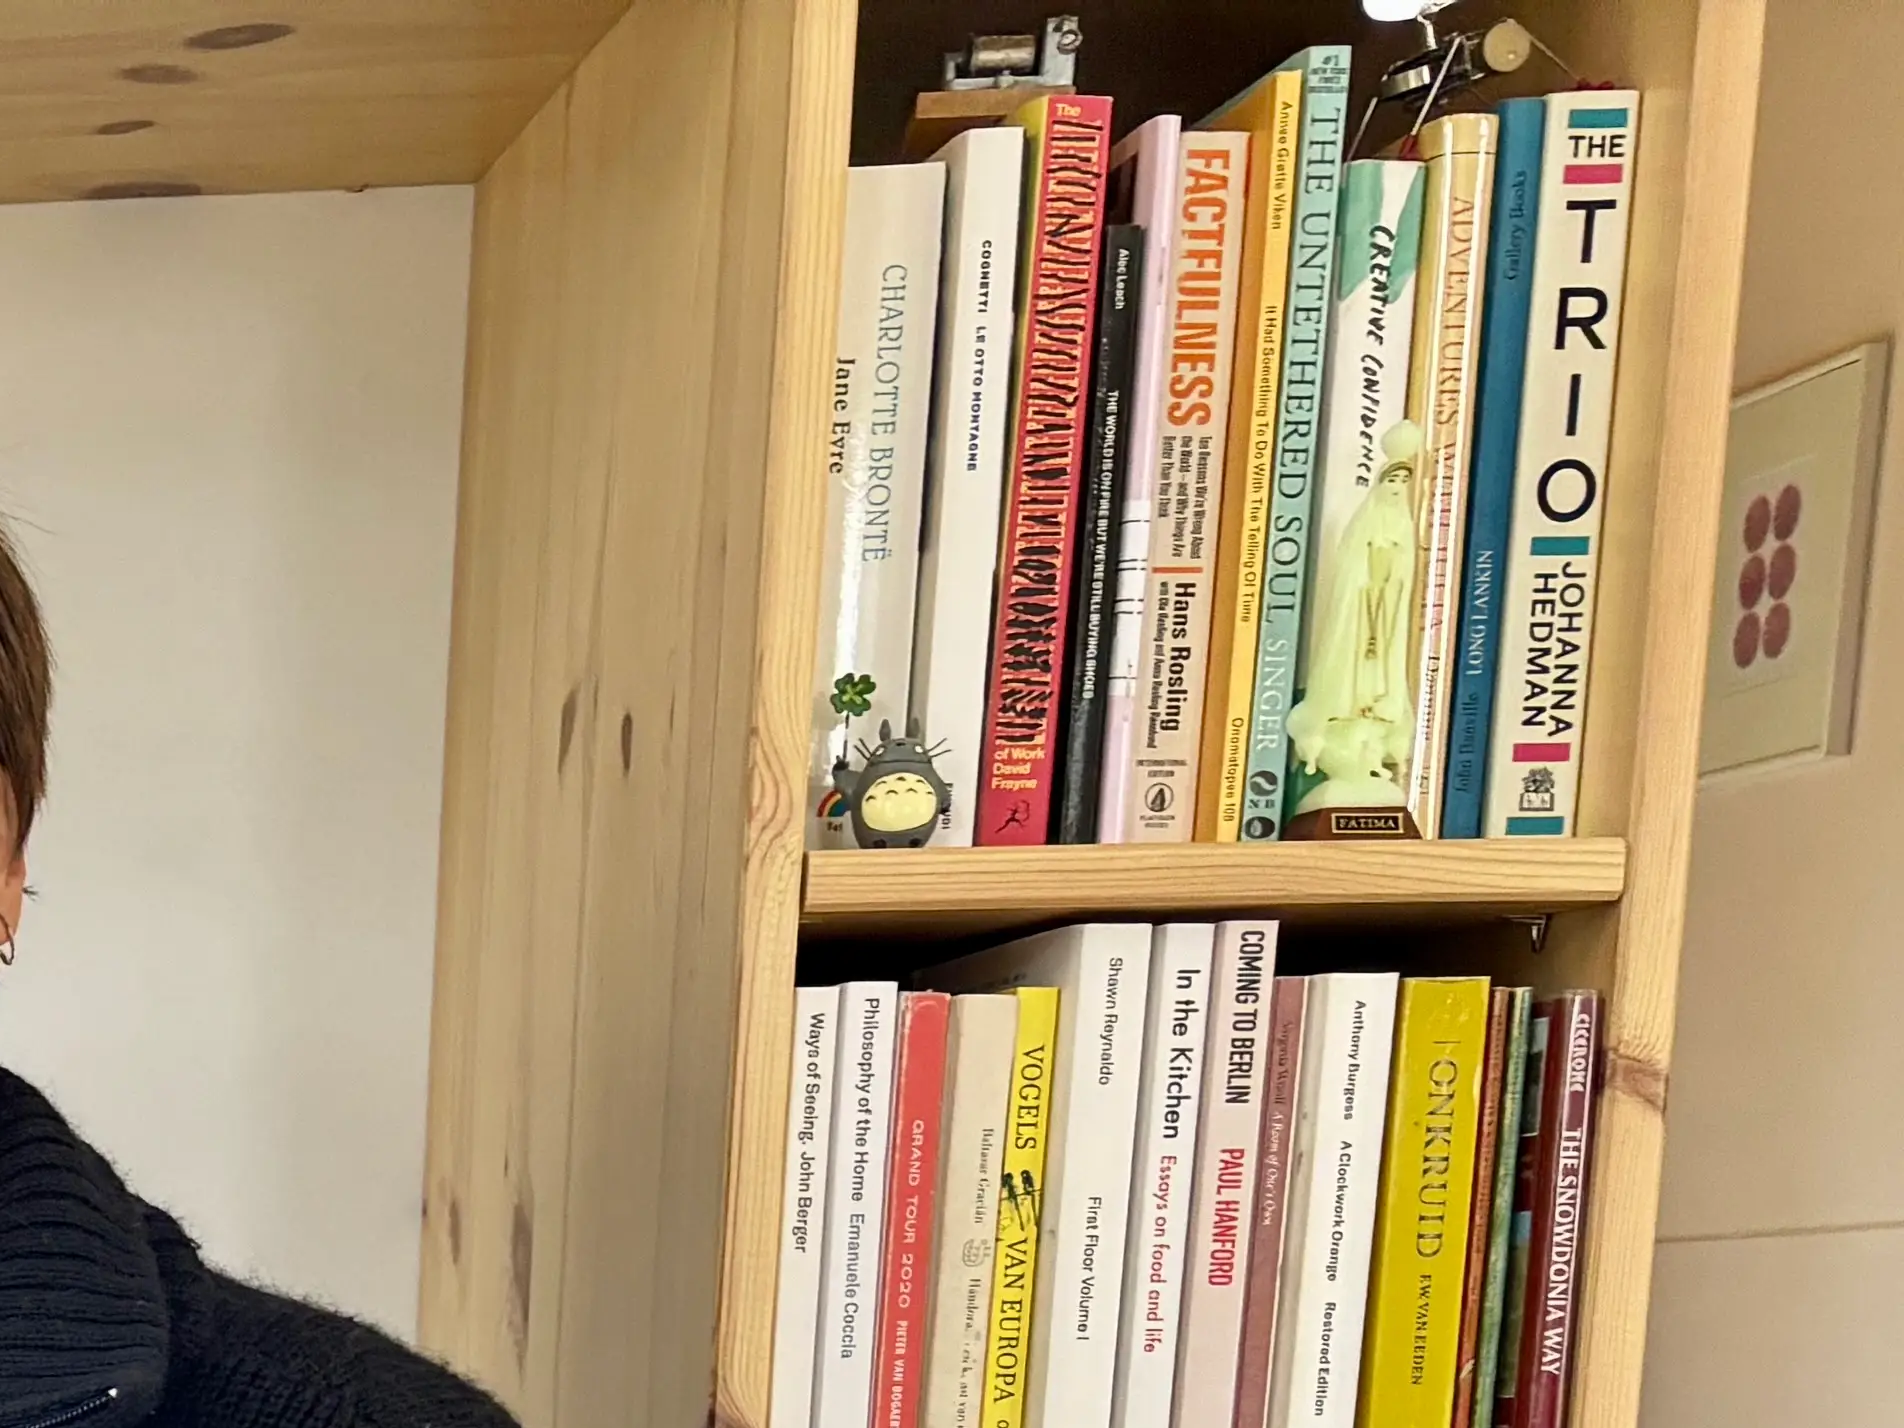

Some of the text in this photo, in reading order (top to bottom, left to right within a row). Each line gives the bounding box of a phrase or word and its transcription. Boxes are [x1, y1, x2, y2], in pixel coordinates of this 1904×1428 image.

[1304, 107, 1341, 194] THE
[1568, 134, 1628, 158] THE
[1117, 248, 1131, 272] Alec
[1167, 150, 1231, 429] FACTFULNESS
[1437, 197, 1475, 427] ADVENTURES
[966, 239, 993, 471] COGNETTI LE OTTO MONTAGNE
[1277, 211, 1331, 499] UNTETHERED
[1355, 225, 1396, 488] CREATIVE CONFIDENCE
[1537, 199, 1617, 523] TRIO
[828, 357, 856, 476] Jane Eyre
[861, 264, 908, 562] CHARLOTTE BRONTË
[1171, 583, 1197, 639] Hans
[1266, 514, 1302, 624] SOUL
[1465, 550, 1494, 676] LONG LANKIN
[1159, 646, 1192, 732] Rosling
[1255, 637, 1288, 751] SINGER
[1520, 572, 1559, 728] HEDMAN
[1547, 561, 1587, 738] JOHANNA
[1338, 816, 1396, 830] FATIMA
[806, 1013, 825, 1056] Ways
[1105, 958, 1123, 1009] Shawn
[806, 1061, 821, 1079] of
[1014, 1044, 1045, 1150] VOGELS
[1098, 1014, 1118, 1085] Reynaldo
[1143, 968, 1201, 1353] In the Kitchen Essays on food and life
[1208, 930, 1266, 1286] COMING TO BERLIN PAUL HANFORD
[1414, 1058, 1460, 1259] ONKRUID
[792, 1196, 812, 1253] Berger
[799, 1152, 816, 1192] John
[839, 998, 881, 1358] Philosophy of the Home Emanuele Coccia
[897, 1119, 925, 1308] GRAND TOUR 2020
[1084, 1196, 1103, 1231] First
[1314, 1000, 1368, 1416] Anthony Burgess A Clockwork Orange Restored Edition
[1001, 1237, 1028, 1289] VAN
[1076, 1277, 1096, 1333] Volume
[1081, 1234, 1100, 1272] Floor
[1539, 1129, 1583, 1375] THE SNOWDONIA WAY
[991, 1299, 1022, 1404] EUROPA
